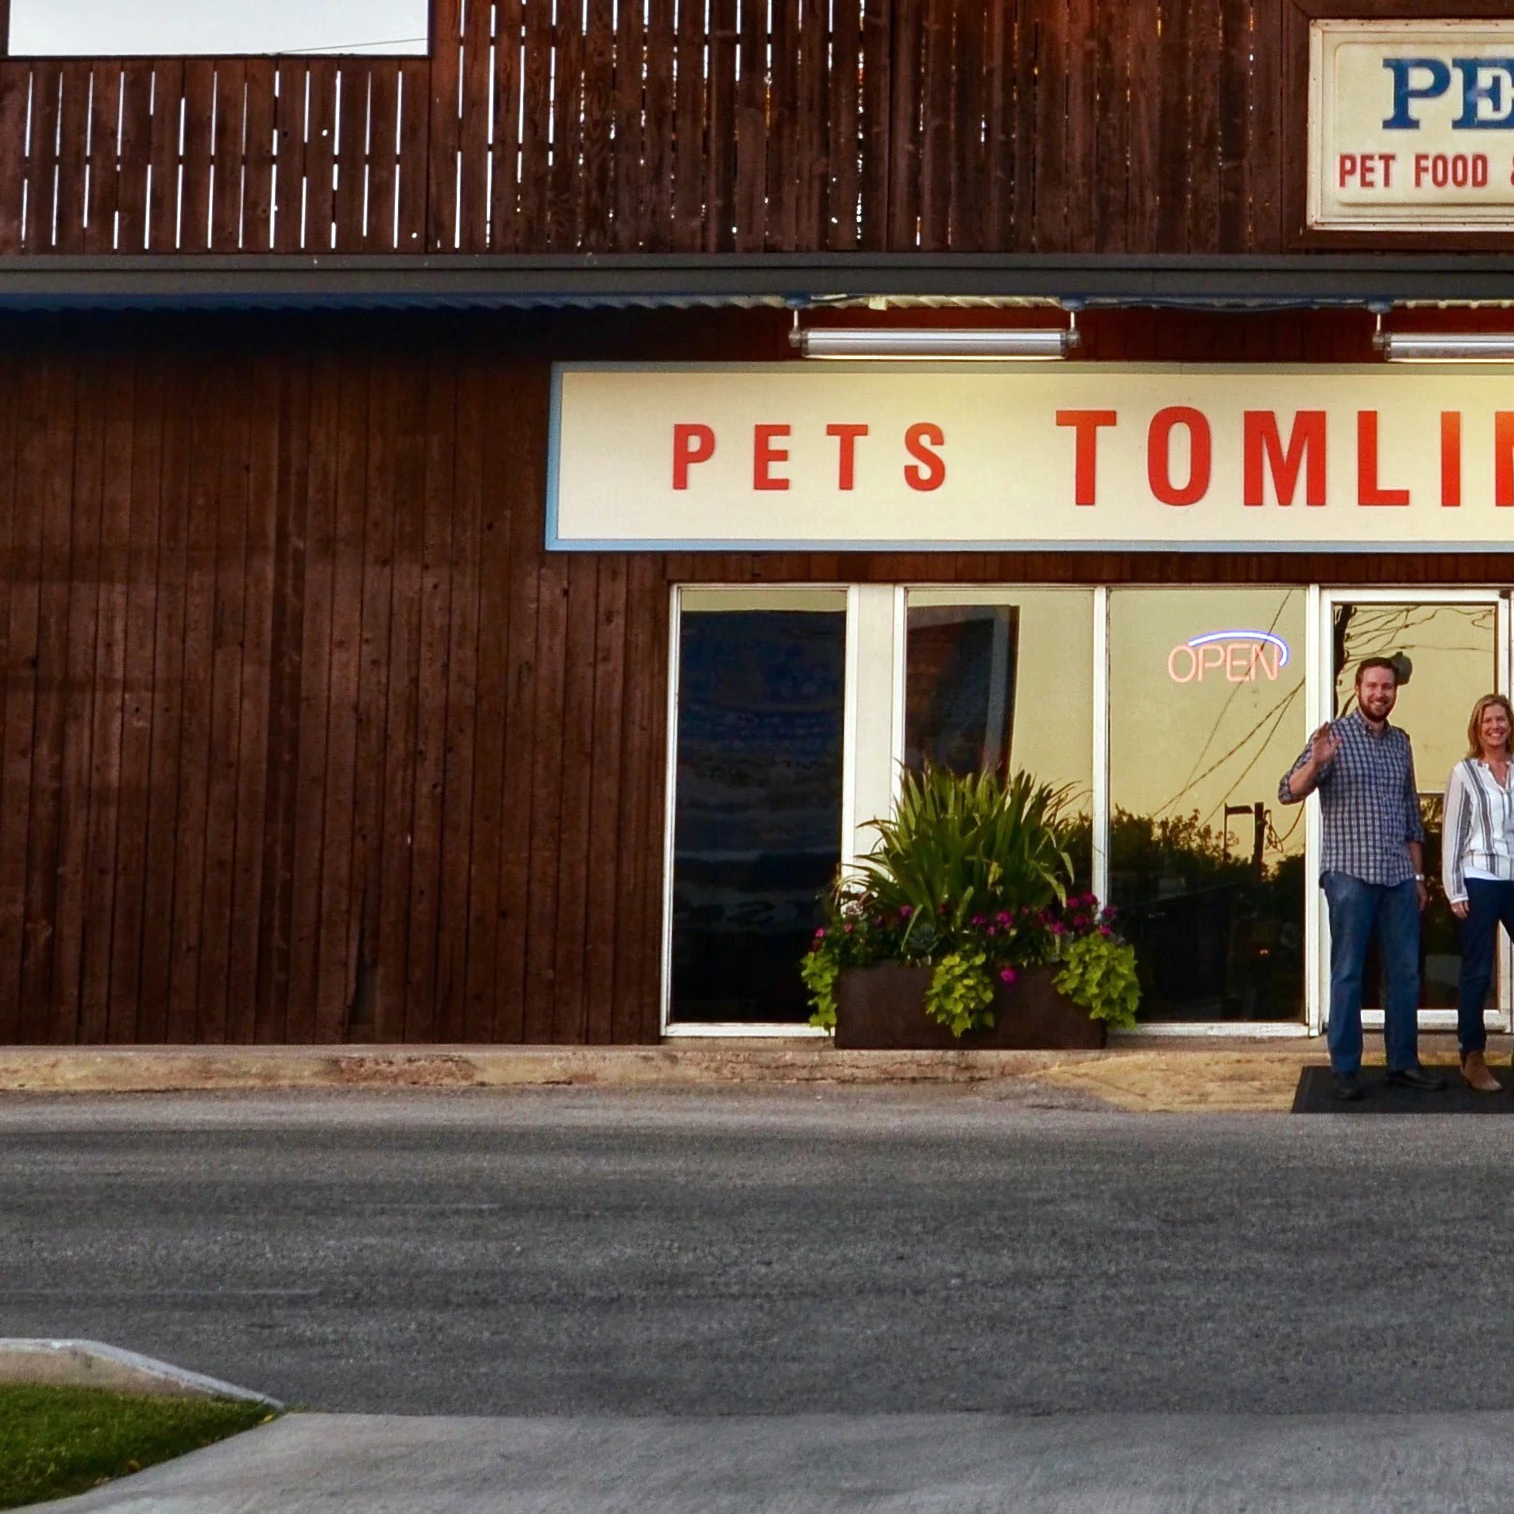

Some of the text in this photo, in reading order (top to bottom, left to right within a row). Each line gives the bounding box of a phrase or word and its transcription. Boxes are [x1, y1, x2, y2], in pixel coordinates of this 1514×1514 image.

[1339, 154, 1395, 188] PET
[1414, 154, 1489, 188] FOOD
[672, 422, 946, 492] PETS
[1167, 642, 1278, 683] OPEN
